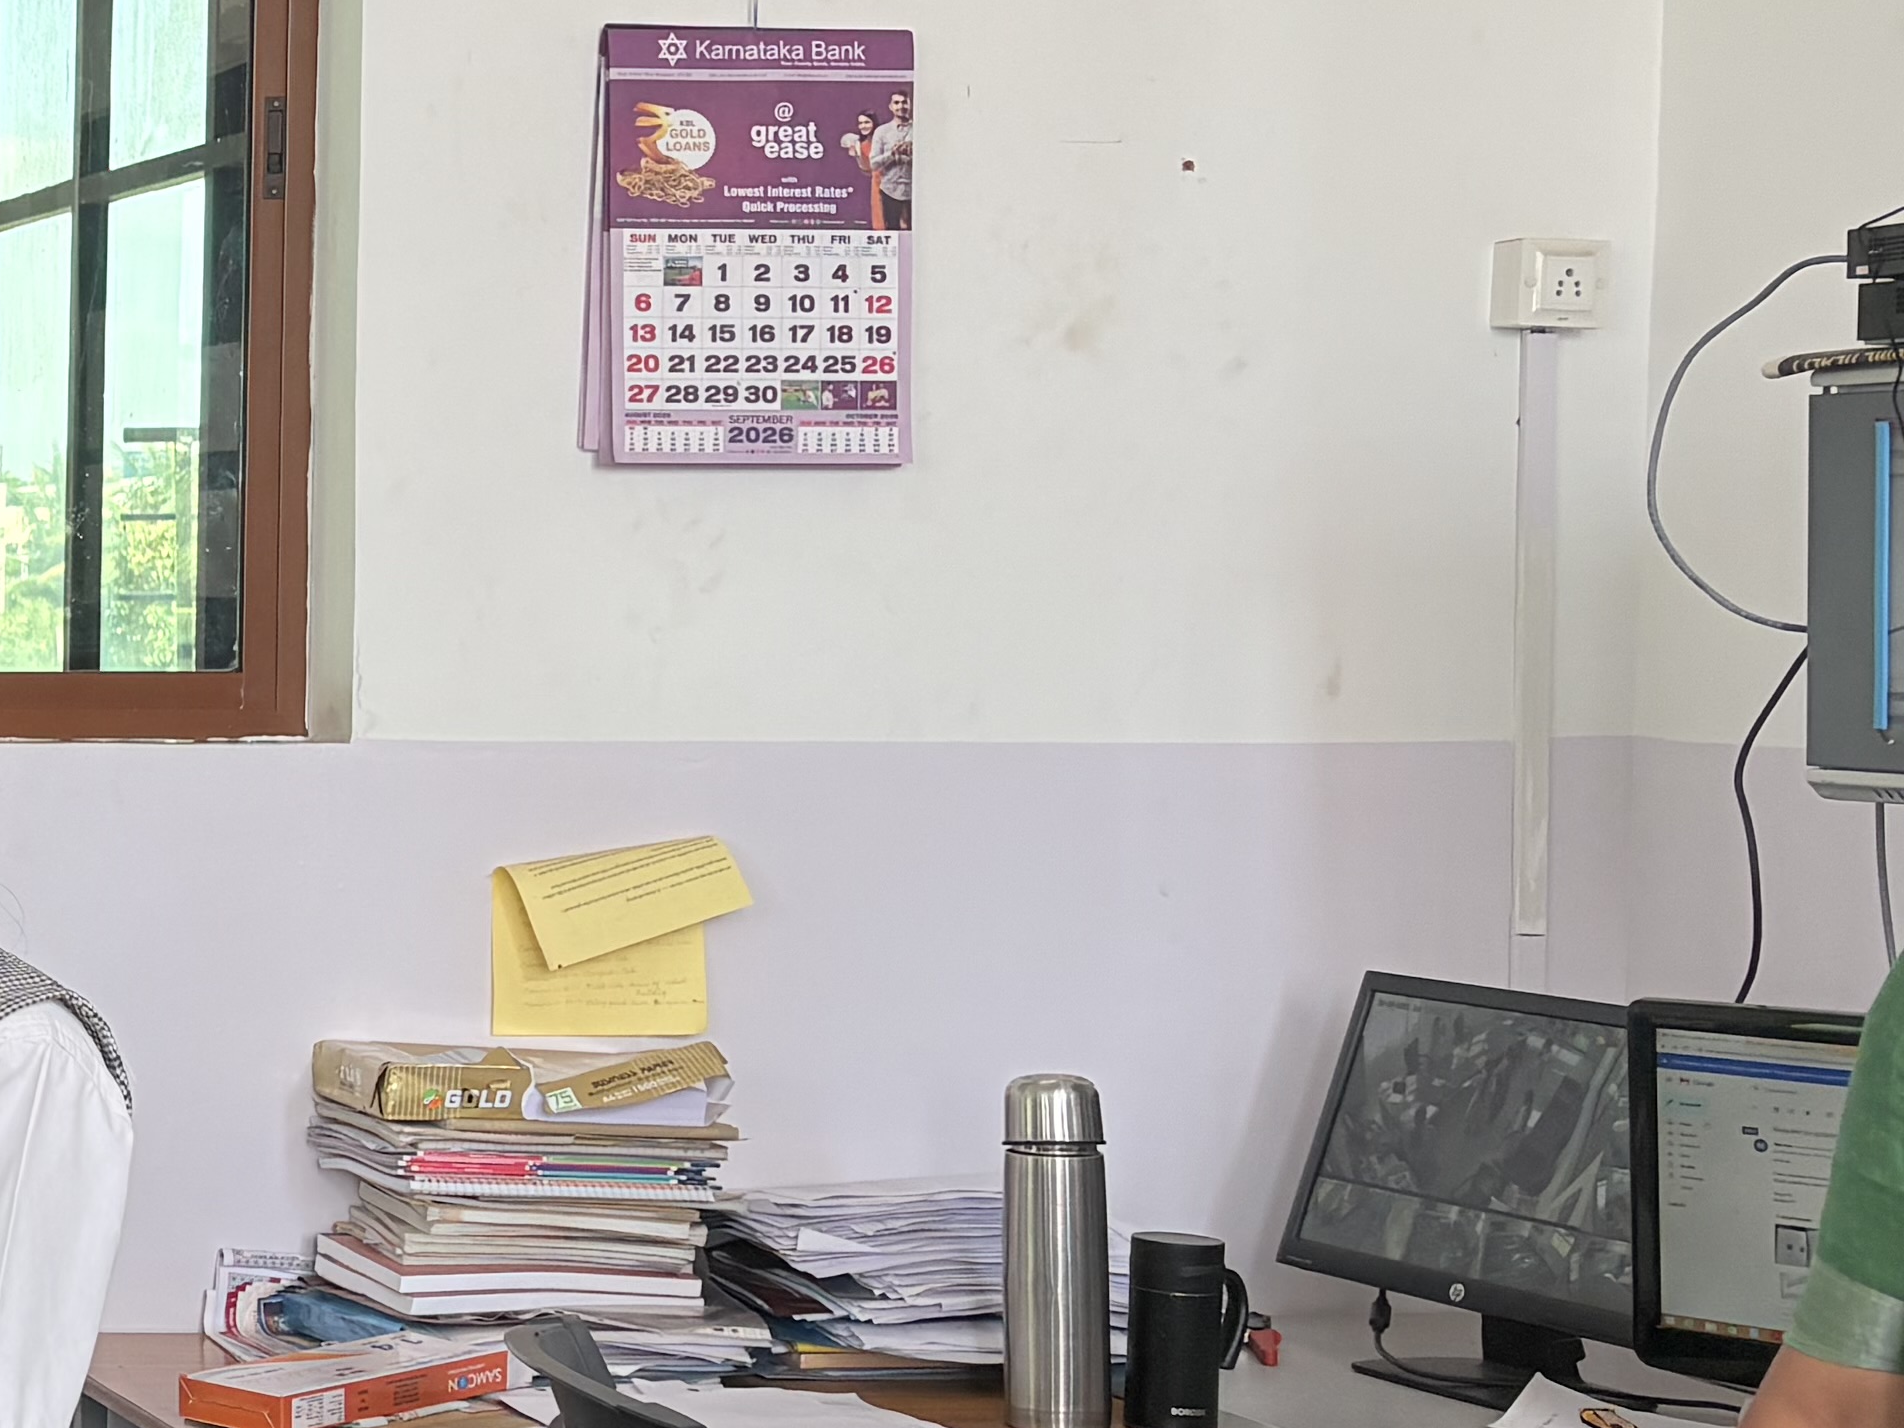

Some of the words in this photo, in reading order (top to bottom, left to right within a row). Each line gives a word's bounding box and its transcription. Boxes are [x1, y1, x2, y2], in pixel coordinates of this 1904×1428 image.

[696, 40, 804, 61] Karnataka
[811, 41, 866, 61] Bank
[774, 102, 794, 122] @
[669, 128, 707, 140] GOLD
[750, 122, 818, 149] great
[666, 141, 711, 153] LOANS
[764, 142, 824, 159] ease
[723, 186, 764, 198] Lowest
[767, 186, 812, 199] Interest
[742, 201, 774, 214] Quick
[777, 202, 837, 215] Processing
[629, 234, 656, 243] SUN
[668, 234, 697, 243] MON
[711, 234, 735, 243] TUE
[749, 235, 777, 243] WED
[790, 235, 815, 244] THU
[831, 235, 850, 244] FRI
[867, 236, 891, 245] SAT
[718, 263, 727, 282] 1
[754, 264, 771, 282] 2
[793, 264, 810, 282] 3
[832, 264, 849, 283] 4
[871, 265, 886, 283] 5
[634, 294, 651, 312] 6
[674, 294, 691, 312] 7
[714, 294, 730, 312] 8
[754, 295, 771, 312] 9
[789, 295, 815, 313] 10
[830, 295, 849, 313] 11
[865, 296, 892, 314] 12
[630, 324, 656, 342] 13
[668, 324, 695, 342] 14
[708, 324, 735, 342] 15
[749, 325, 775, 342] 16
[789, 325, 815, 343] 17
[827, 326, 853, 343] 18
[865, 326, 891, 344] 19
[626, 355, 659, 372] 20
[668, 355, 695, 373] 21
[704, 355, 739, 373] 22
[745, 355, 778, 373] 23
[783, 355, 818, 373] 24
[823, 356, 856, 373] 25
[862, 356, 895, 374] 26
[628, 385, 660, 403] 27
[665, 385, 699, 403] 28
[704, 385, 738, 403] 29
[744, 386, 778, 403] 30
[729, 415, 793, 424] SEPTEMBER
[728, 427, 793, 443] 2026
[547, 1092, 575, 1106] 75
